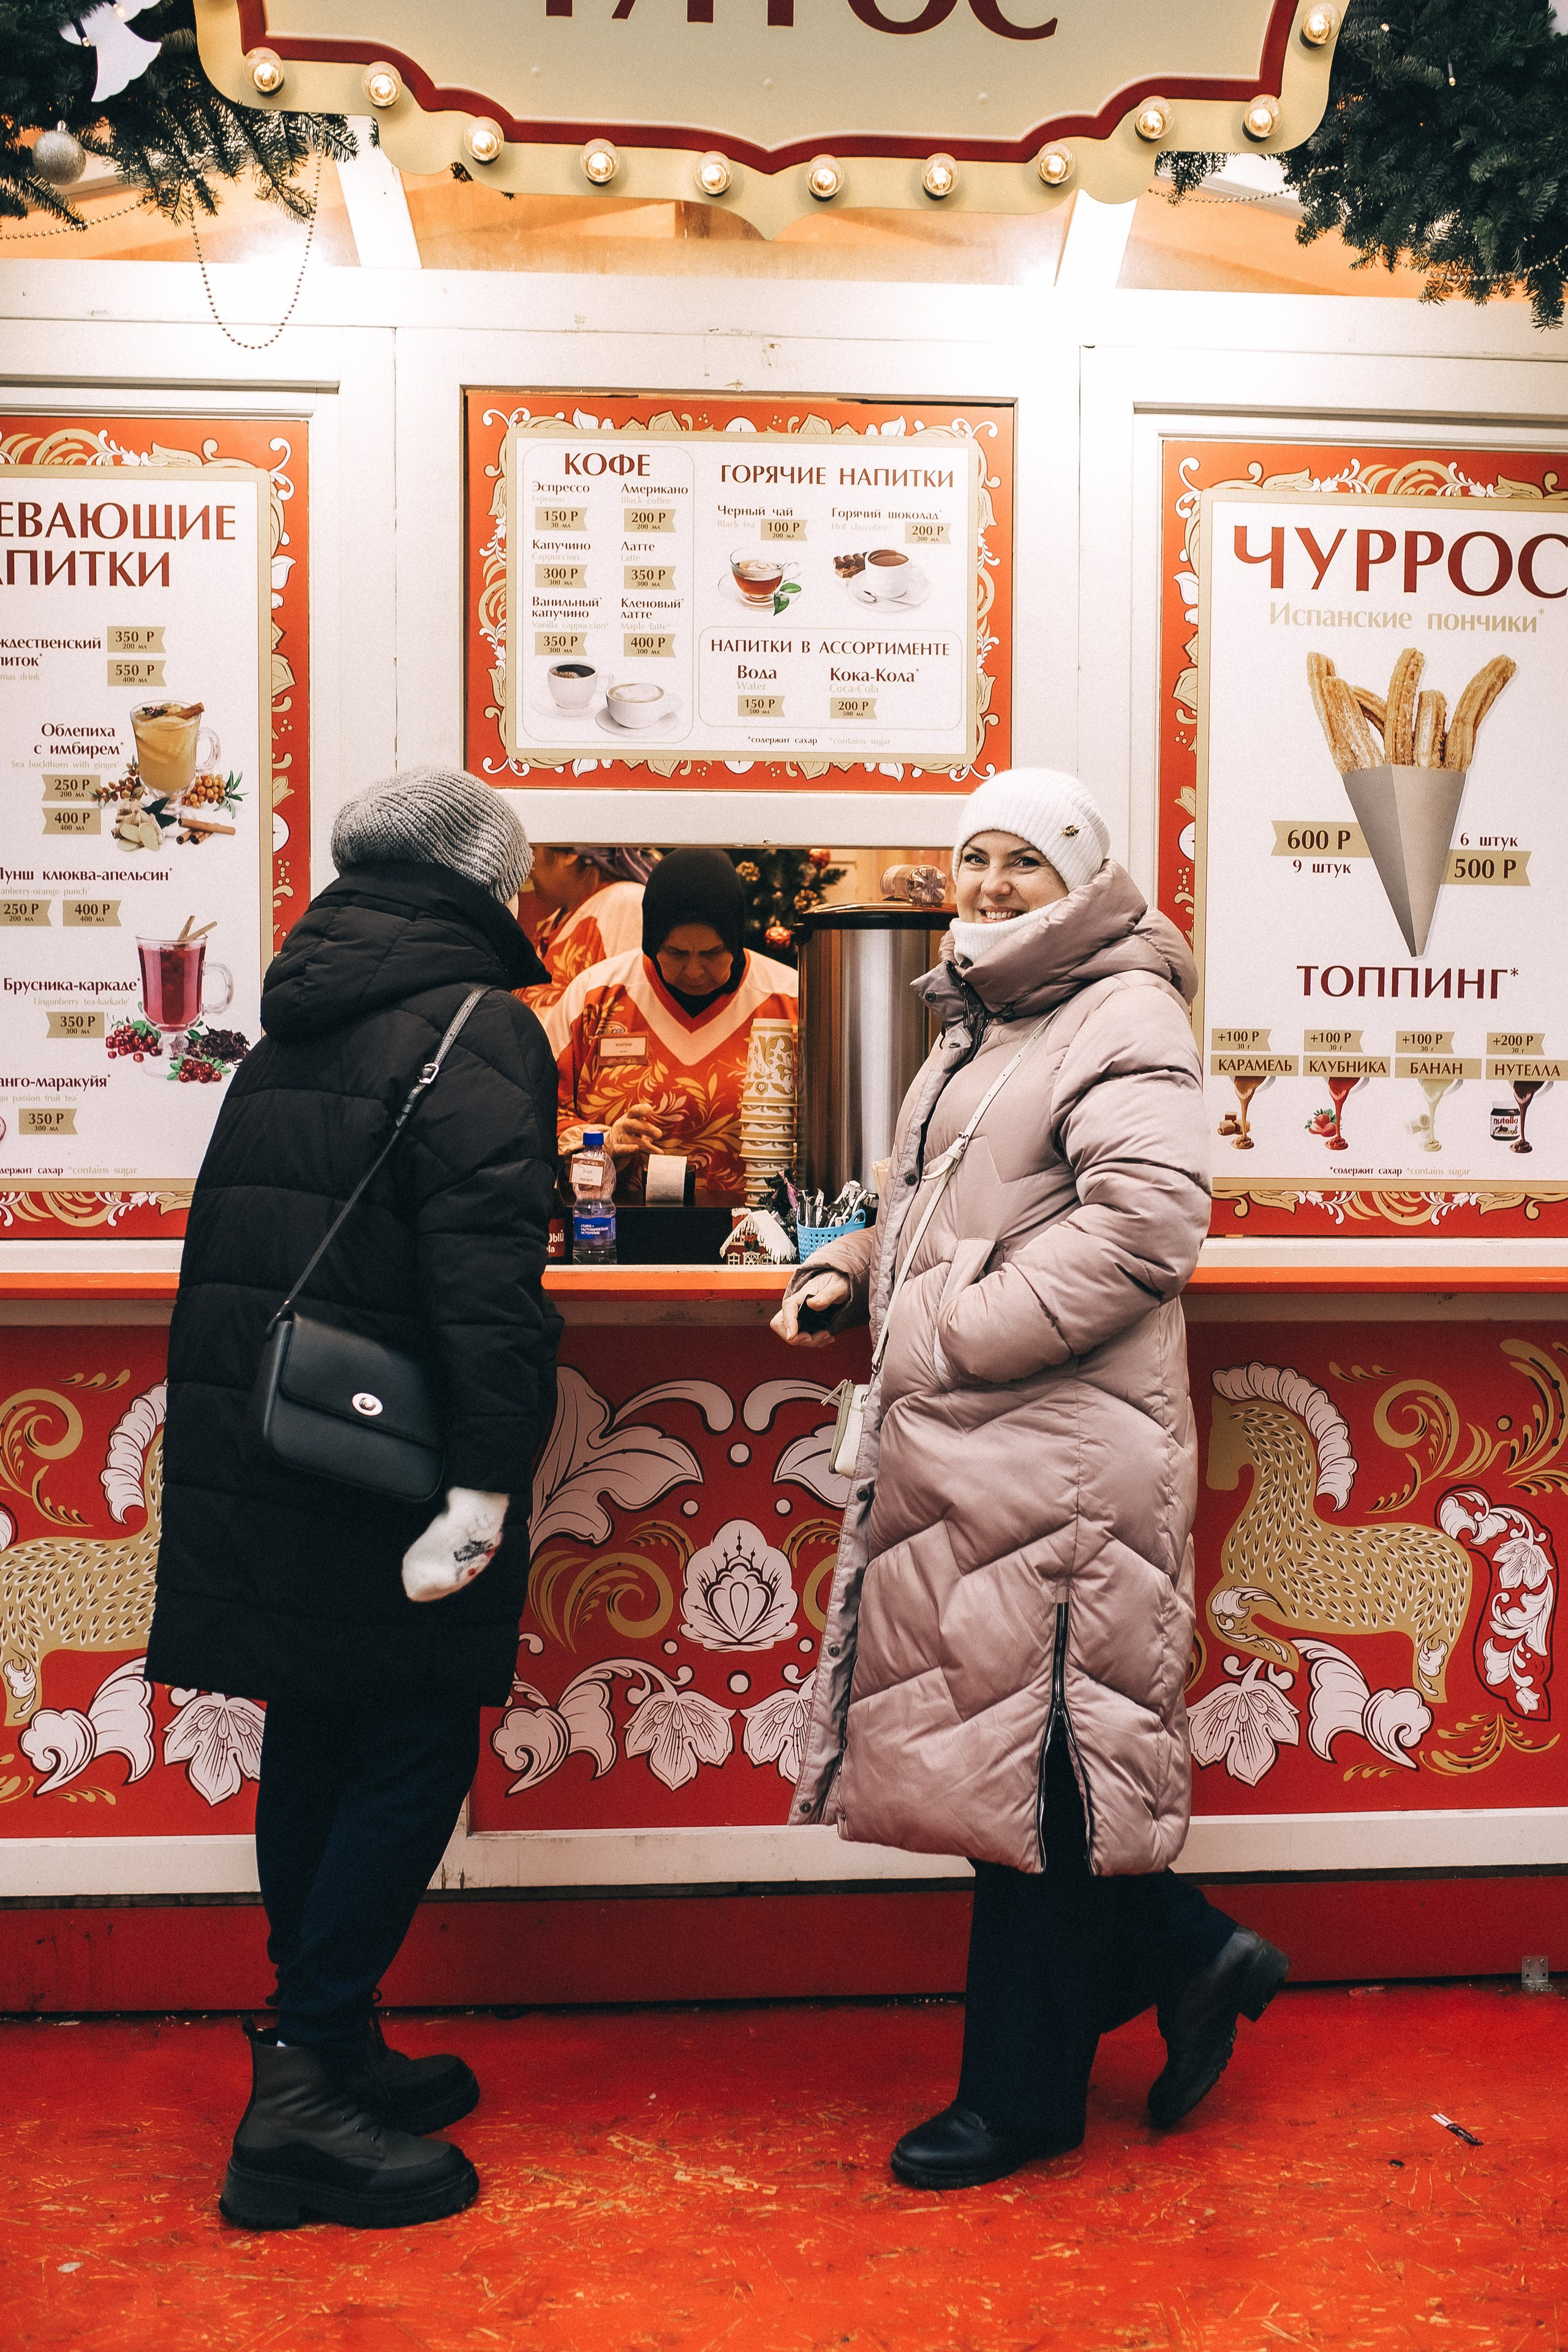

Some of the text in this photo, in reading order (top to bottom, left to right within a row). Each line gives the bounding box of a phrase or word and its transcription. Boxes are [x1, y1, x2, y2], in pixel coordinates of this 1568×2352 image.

[565, 453, 650, 476] КОФЕ
[722, 465, 952, 488] ГОРЯЧИЕ НАПИТКИ
[532, 481, 590, 495] Эспрессо
[622, 483, 688, 497] Американо
[545, 511, 578, 521] 150 Р
[718, 505, 793, 519] Черный чай
[832, 508, 881, 521] Горячий
[631, 513, 666, 523] 200 Р
[768, 522, 799, 532] 100 Р
[912, 526, 943, 535] 200 Р
[533, 540, 590, 552] Капучино
[621, 541, 655, 551] Латте
[0, 549, 169, 587] ПИТКИ
[1234, 526, 1568, 599] ЧУРРОС
[544, 568, 578, 579] 300 Р
[631, 570, 665, 580] 350 Р
[532, 610, 589, 620] капучино
[1270, 603, 1412, 629] Испанские
[116, 631, 154, 643] 350 Р
[544, 636, 578, 646] 350 Р
[631, 638, 665, 648] 400 Р
[712, 639, 949, 655] НАПИТКИ В АССОРТИМЕНТЕ
[116, 665, 154, 676] 550 Р
[738, 665, 777, 679] Вода
[737, 682, 766, 690] Water
[829, 684, 878, 693] Coca-Cola
[745, 699, 775, 708] 150 Р
[839, 701, 869, 710] 200 Р
[42, 723, 115, 737] Облепиха
[34, 745, 41, 754] с
[29, 760, 68, 768] buckthorn
[55, 779, 89, 791] 250 Р
[55, 812, 90, 824] 400 Р
[1287, 830, 1351, 850] 600 Р
[1460, 833, 1518, 851] 6 штук
[1293, 860, 1351, 878] 9 штук
[1454, 859, 1516, 878] 500 Р
[4, 903, 39, 915] 250 Р
[75, 904, 110, 915] 400 Р
[34, 998, 79, 1006] Lingonberry
[61, 1016, 96, 1027] 350 Р
[1218, 1031, 1259, 1042] +100 Р
[1311, 1032, 1351, 1043] +100 Р
[1403, 1034, 1442, 1044] +100 Р
[1493, 1035, 1533, 1046] +200 Р
[1219, 1059, 1292, 1071] КАРАМЕЛЬ
[1310, 1061, 1386, 1073] КЛУБНИКА
[1411, 1062, 1462, 1074] БАНАН
[1495, 1064, 1560, 1076] НУТЕЛЛА
[29, 1113, 64, 1125] 350 Р
[38, 1168, 63, 1177] сахар
[1448, 1169, 1470, 1178] sugar
